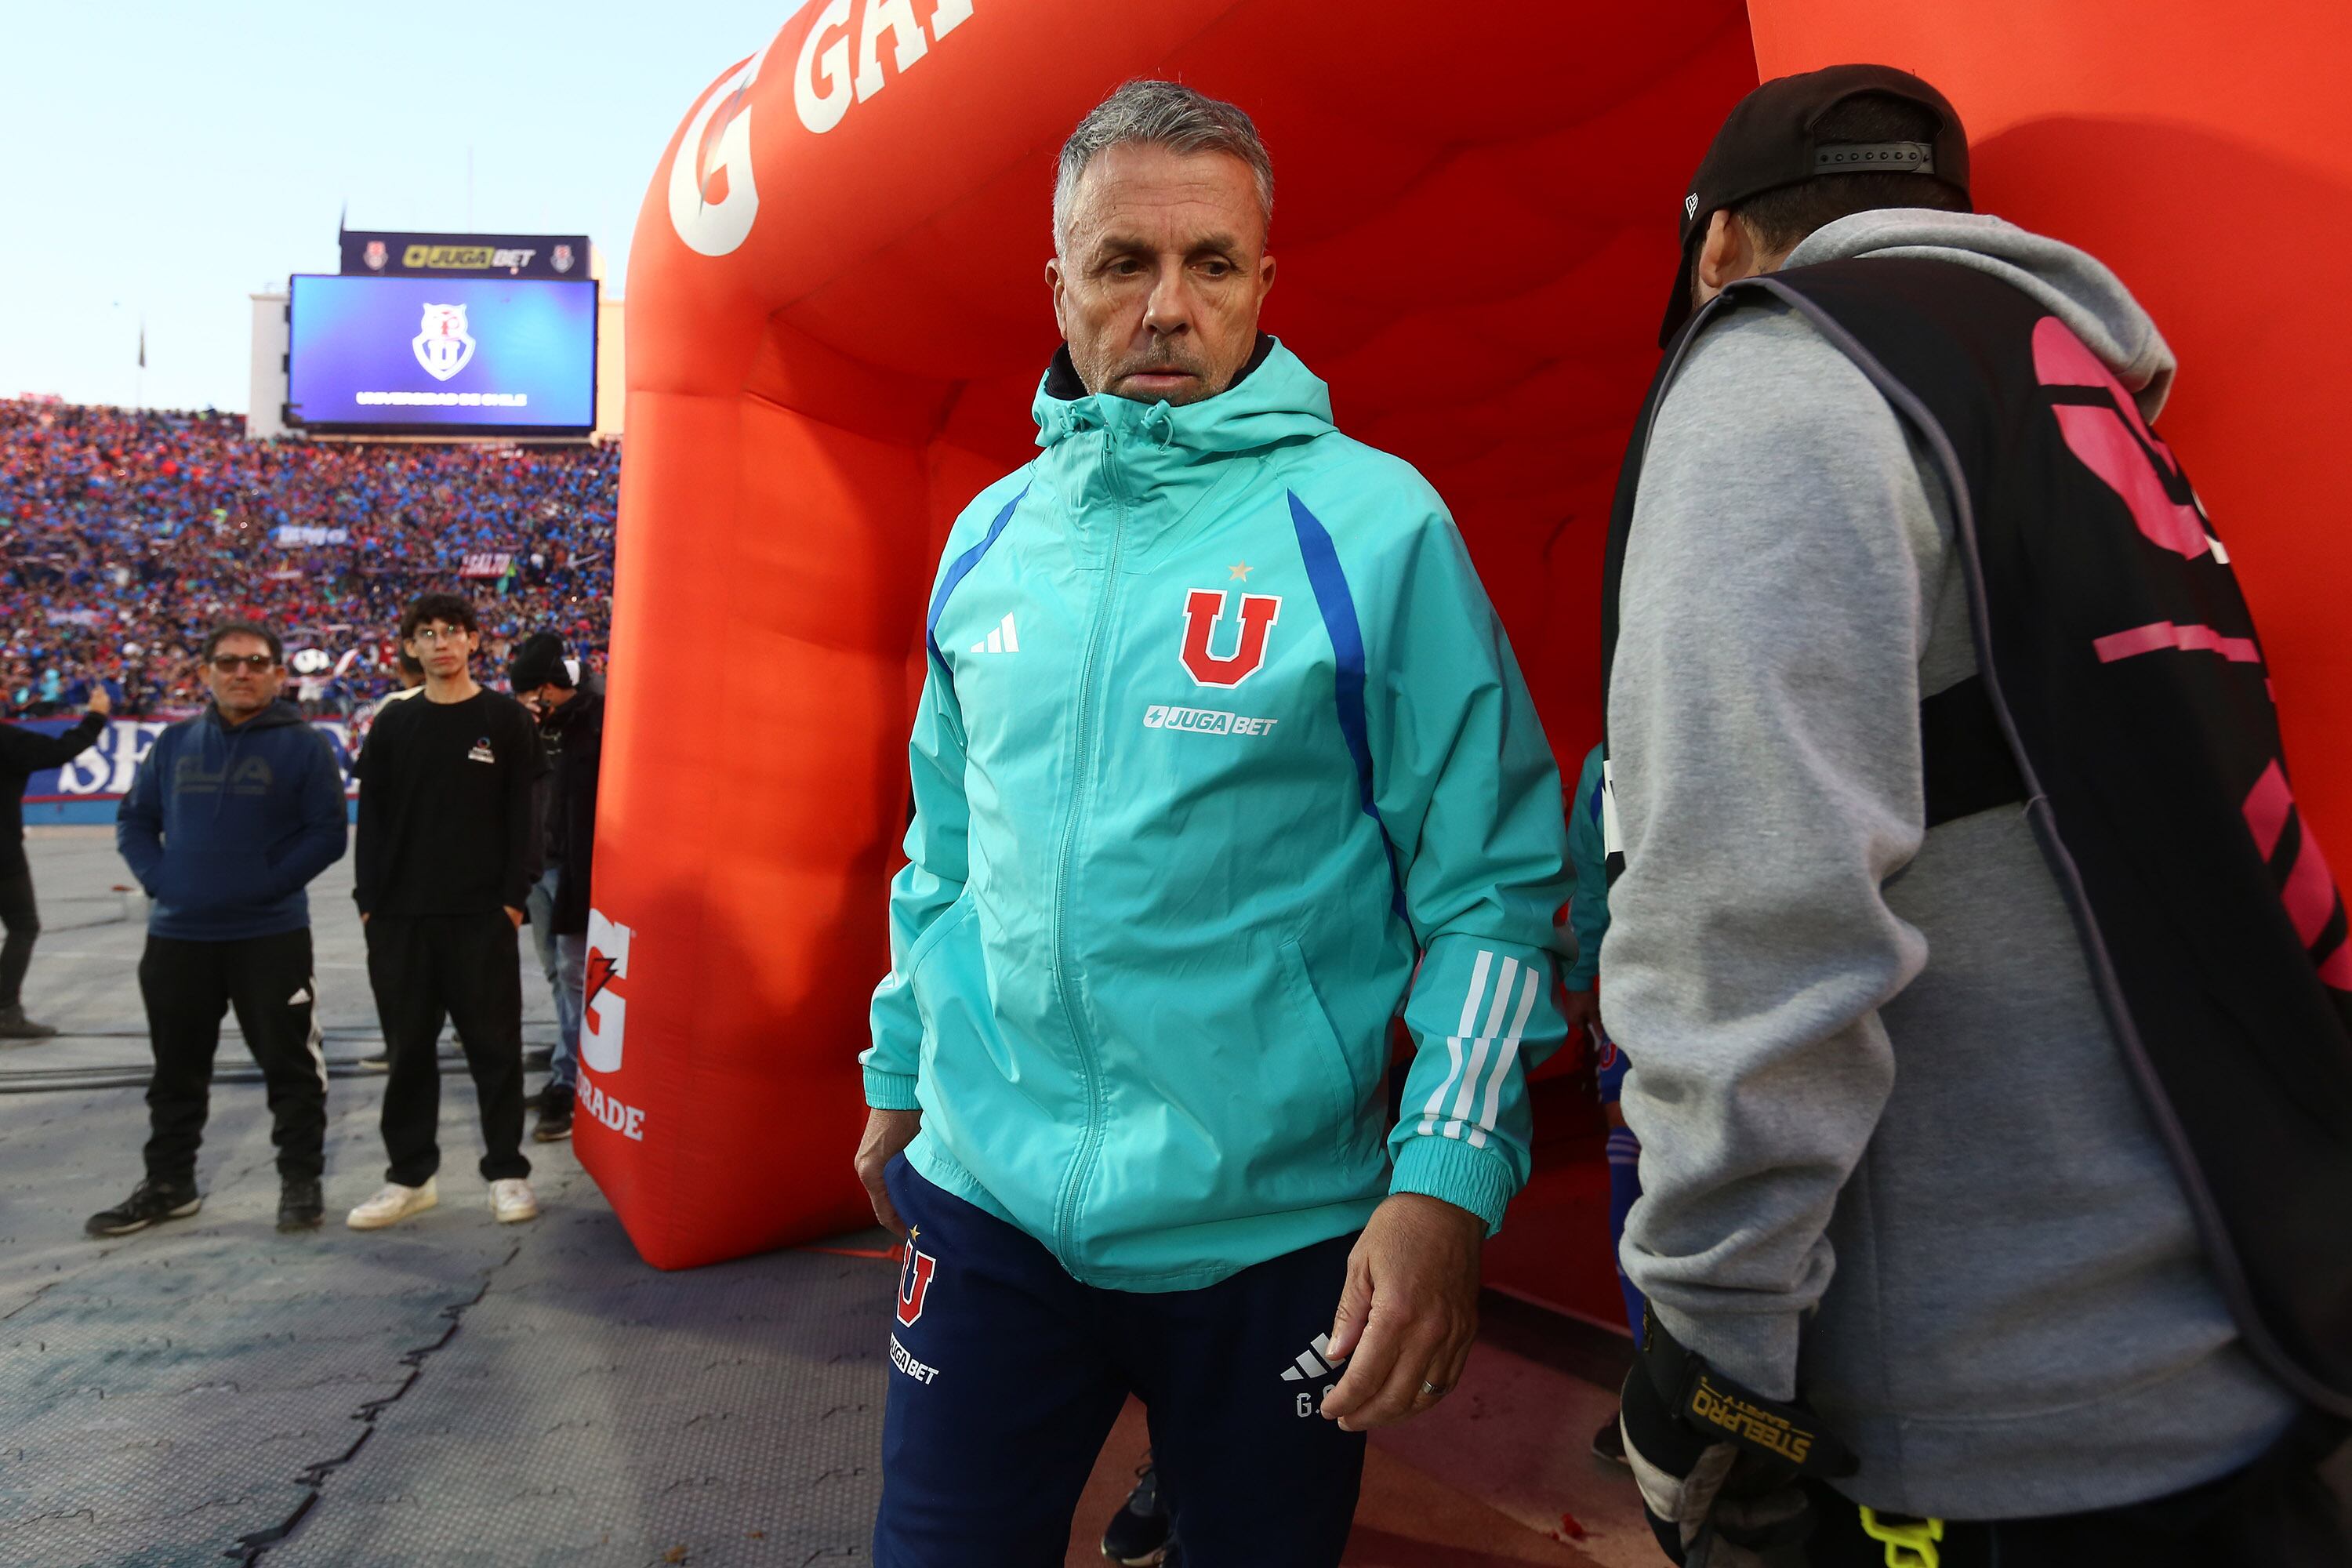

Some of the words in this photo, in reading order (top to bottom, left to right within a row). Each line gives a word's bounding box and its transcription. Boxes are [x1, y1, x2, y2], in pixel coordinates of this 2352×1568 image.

[669, 49, 760, 256] G
[1178, 587, 1283, 689] U
[577, 1067, 645, 1142] RADE
[897, 1239, 936, 1327] U
[890, 1332, 939, 1385] UGABET
[1692, 1388, 1812, 1465] STEELPRO
